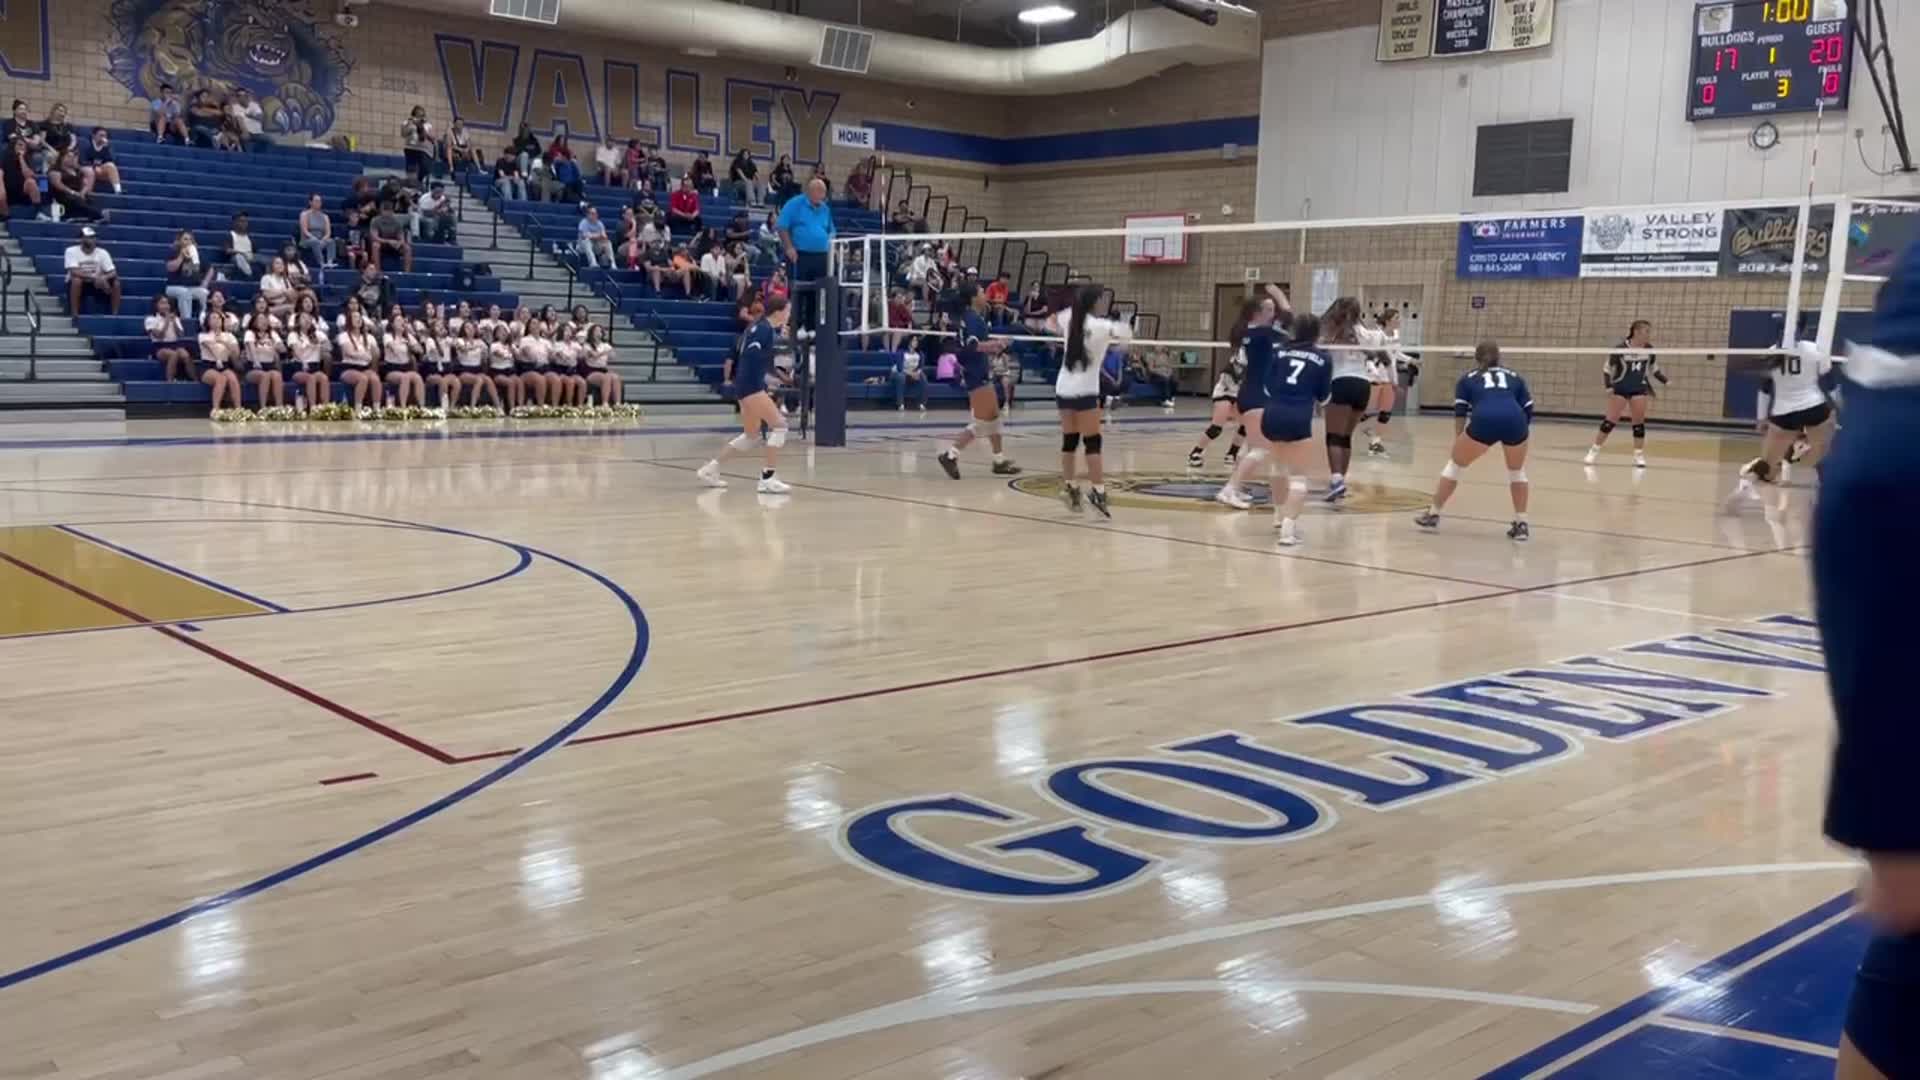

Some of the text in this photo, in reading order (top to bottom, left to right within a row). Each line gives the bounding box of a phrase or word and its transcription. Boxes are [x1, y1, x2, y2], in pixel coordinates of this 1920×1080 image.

[1443, 7, 1484, 20] CHAMPIONS
[1763, 0, 1808, 23] 1:00
[1805, 21, 1842, 36] GUEST
[1701, 30, 1755, 47] BULLDOGS
[1714, 47, 1739, 71] 17
[1769, 47, 1777, 64] 1
[1808, 36, 1844, 64] 20
[1741, 70, 1770, 81] PLAYER
[1824, 73, 1840, 94] 0
[1702, 83, 1717, 105] 0
[1776, 79, 1790, 98] 3
[434, 33, 840, 168] VALLEY
[838, 128, 870, 145] HOME
[1503, 217, 1567, 232] FARMERS
[1645, 211, 1716, 225] VALLEY
[1641, 226, 1717, 241] STRONG
[1732, 217, 1828, 258] Bulldgs
[1531, 250, 1567, 262] AGENCY
[1286, 359, 1306, 385] 7
[1482, 371, 1508, 389] 11
[838, 653, 1780, 902] GOLDEN
